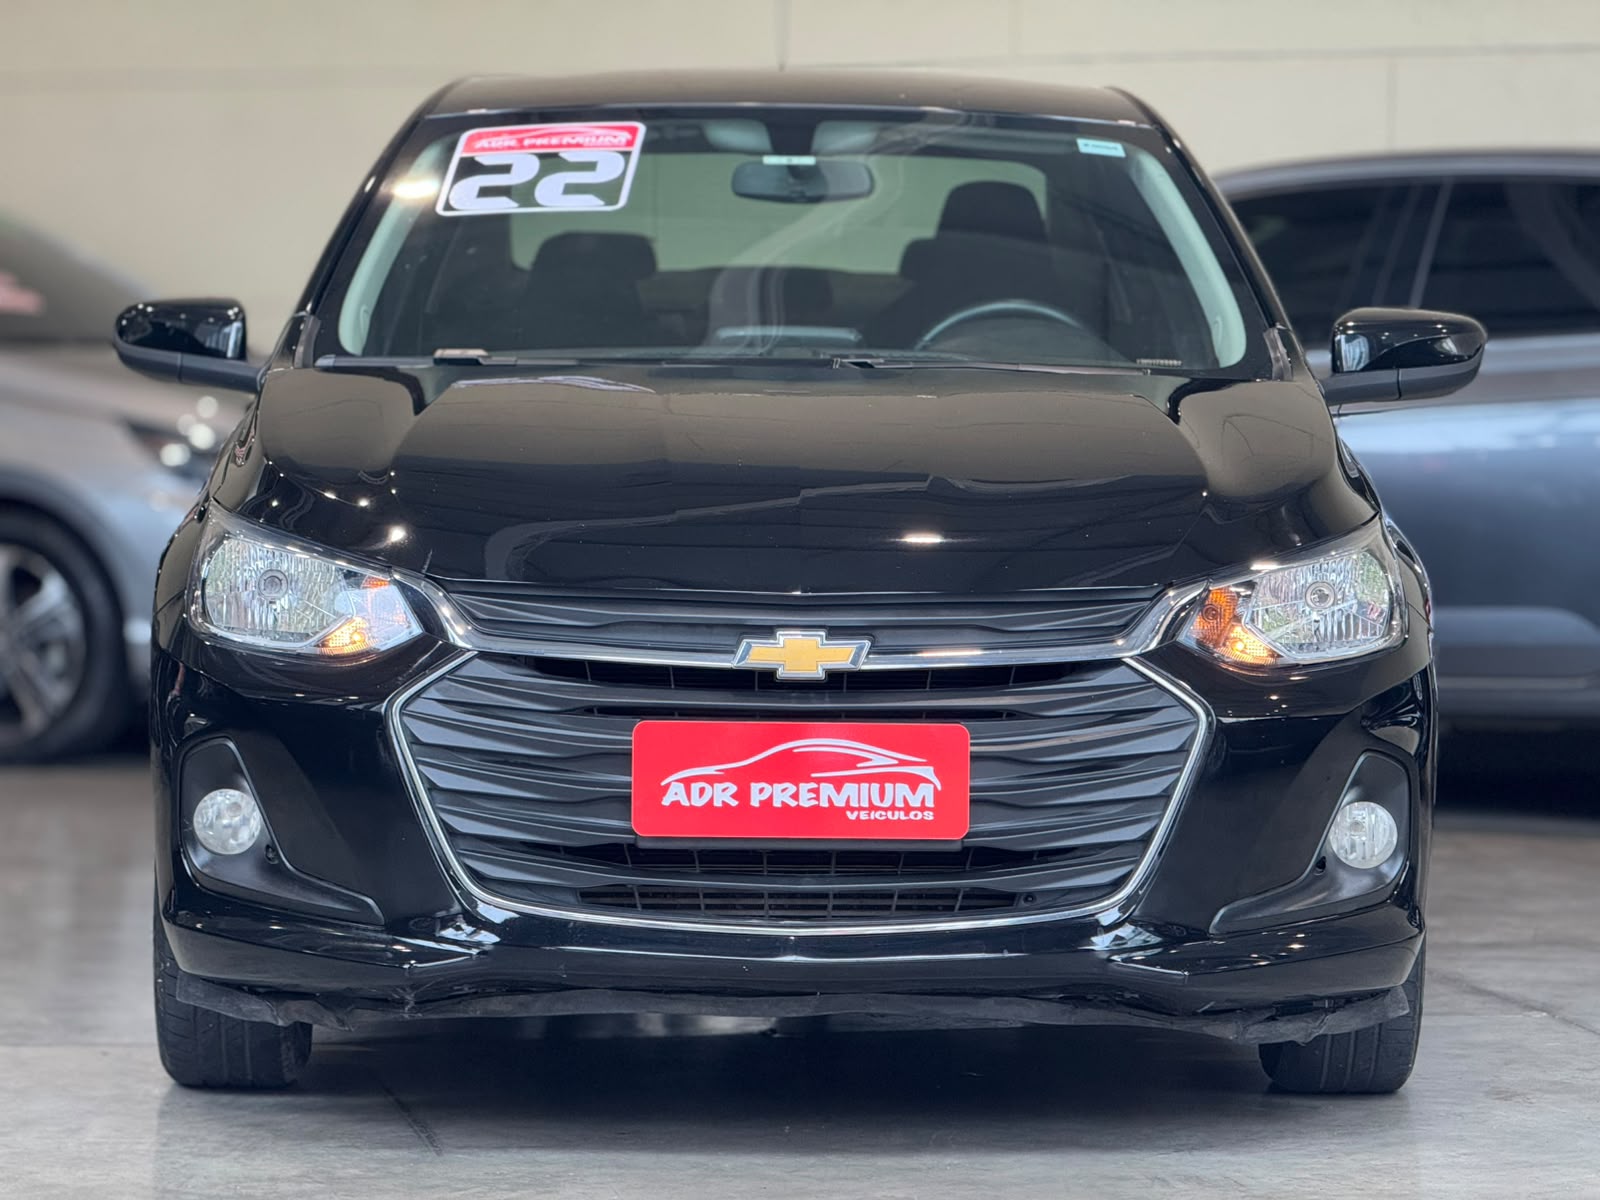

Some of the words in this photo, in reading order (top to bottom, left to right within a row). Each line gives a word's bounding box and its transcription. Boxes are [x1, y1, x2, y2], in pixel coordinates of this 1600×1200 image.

[522, 133, 628, 148] PREMIUM
[449, 152, 625, 210] 22
[661, 781, 739, 807] ADR
[749, 781, 935, 808] PREMIUM
